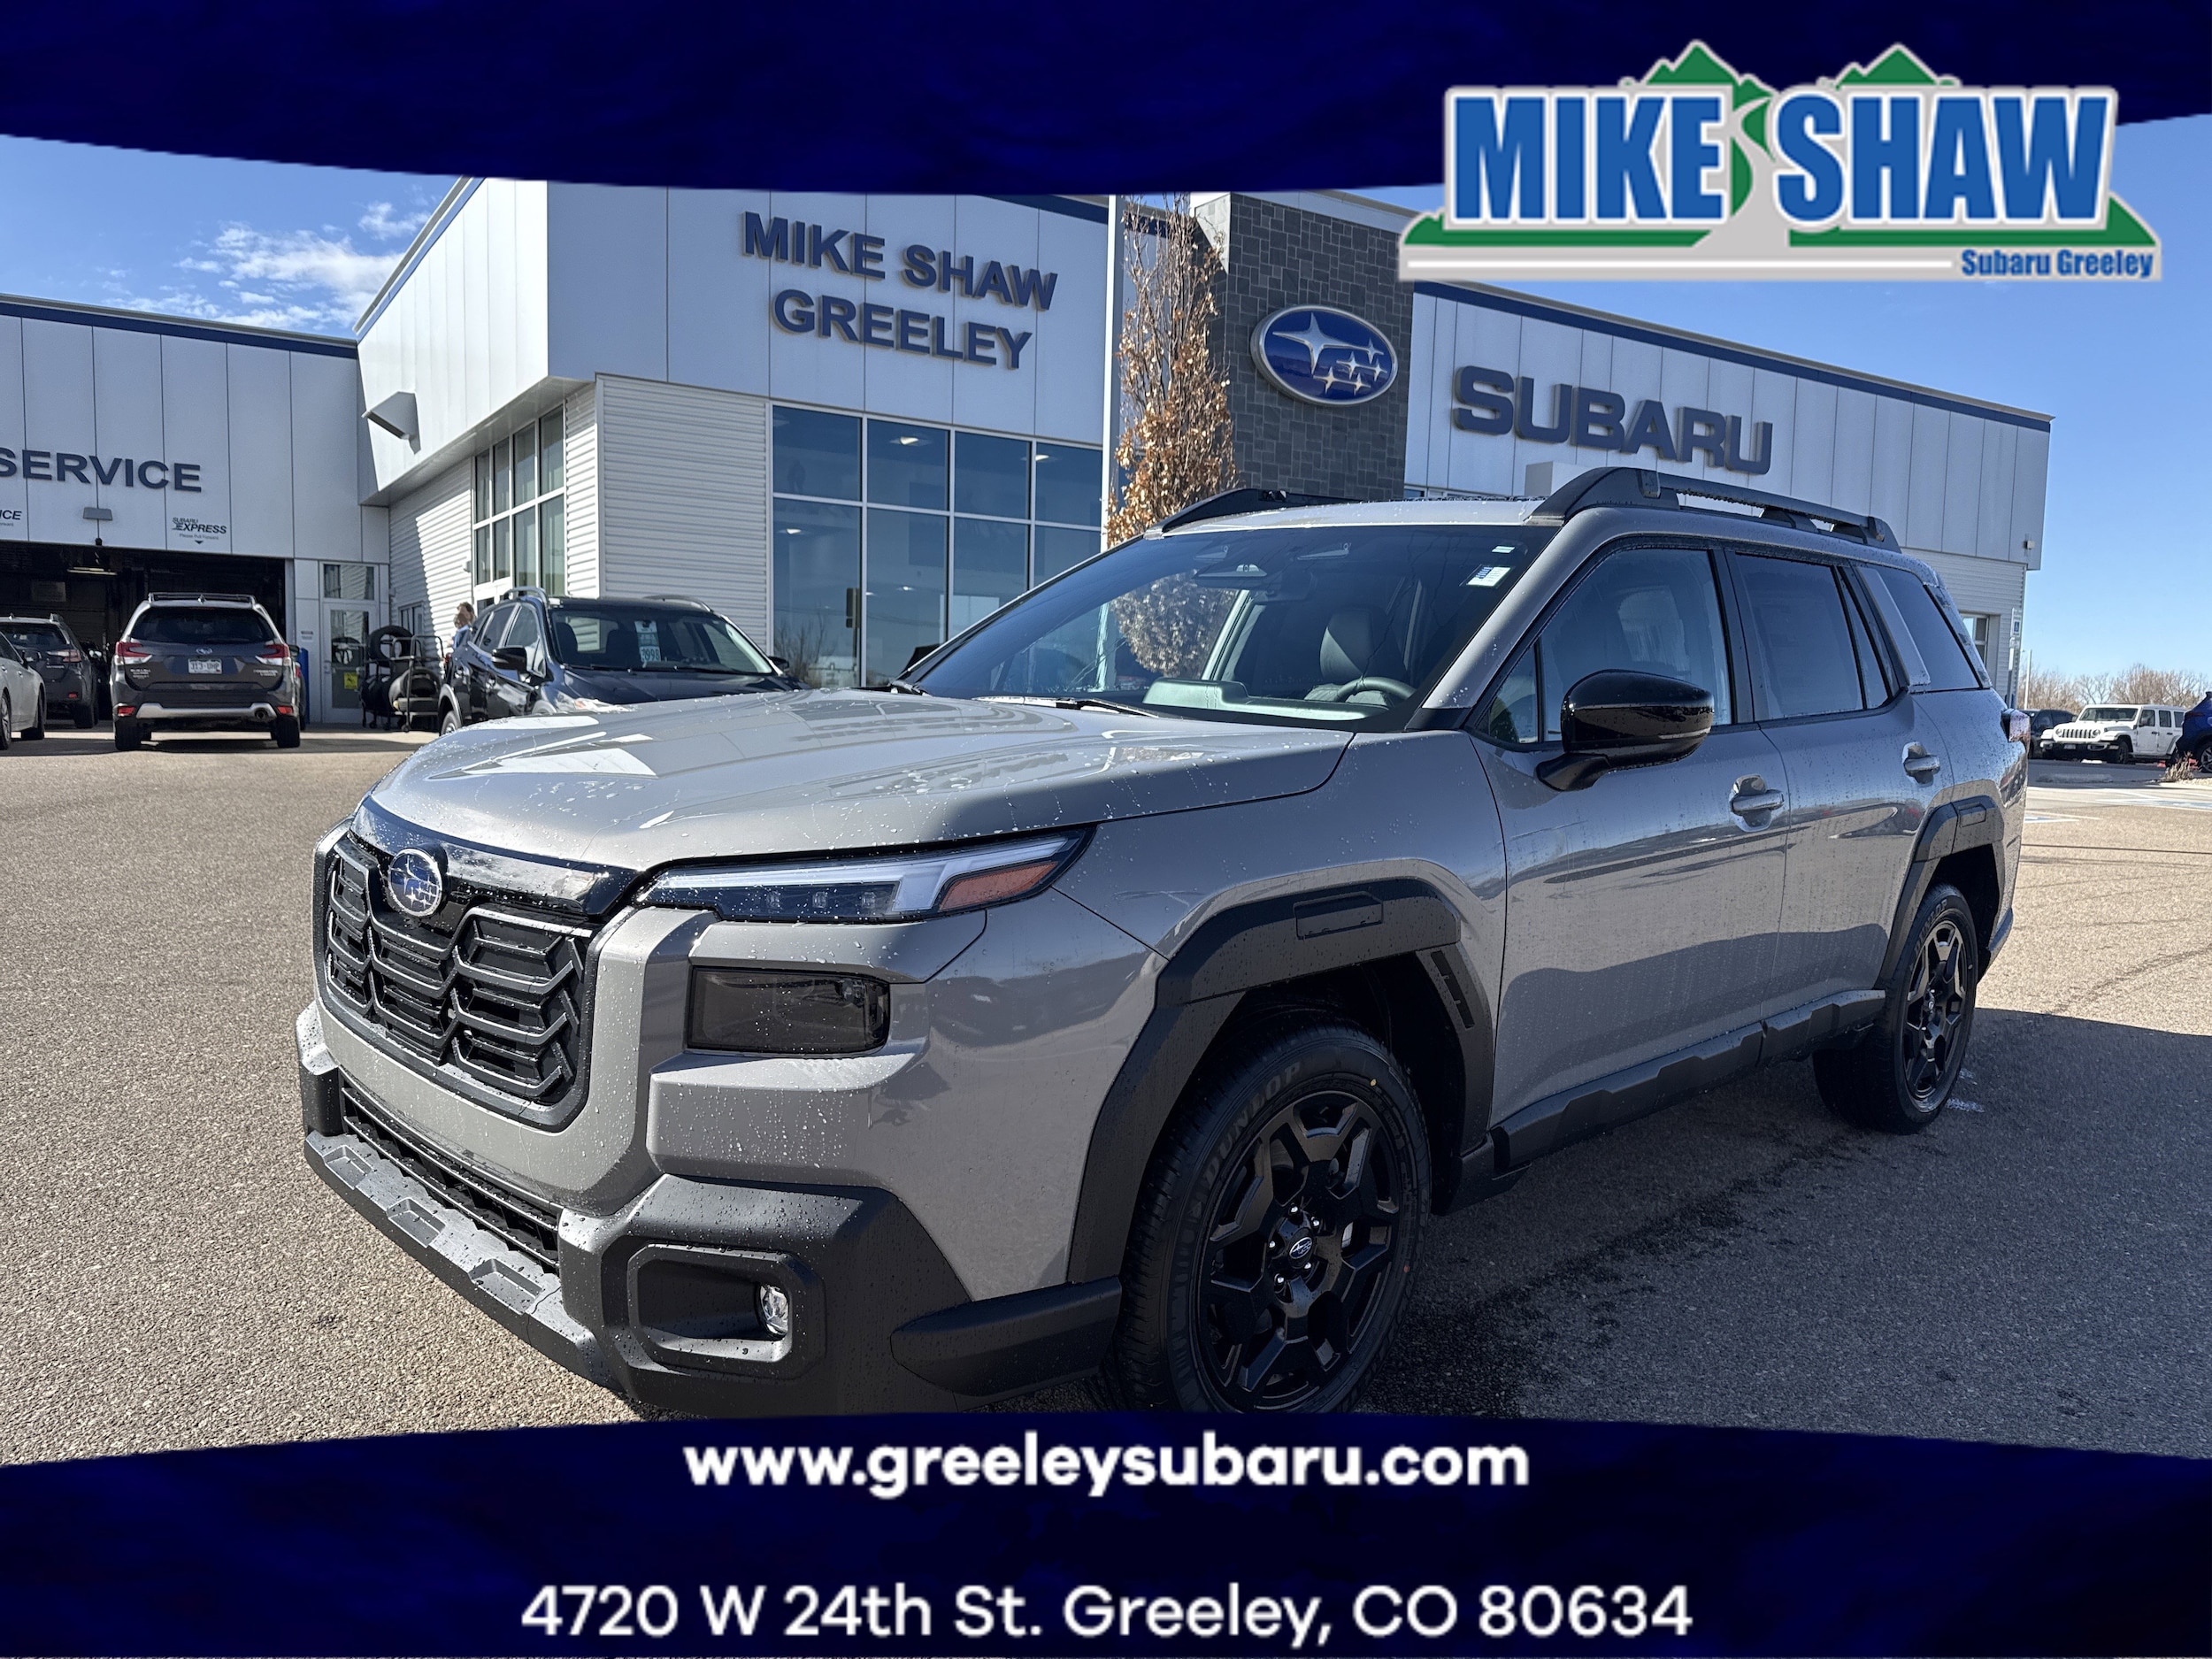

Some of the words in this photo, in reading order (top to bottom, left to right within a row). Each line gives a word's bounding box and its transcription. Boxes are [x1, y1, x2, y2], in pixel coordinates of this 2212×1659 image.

[743, 211, 885, 280] MIKE
[902, 244, 1058, 311] SHAW
[772, 288, 1033, 370] GREELEY
[1453, 365, 1773, 475] SUBARU
[174, 523, 227, 534] EXPRESS
[1202, 1061, 1302, 1190] DUNLOP
